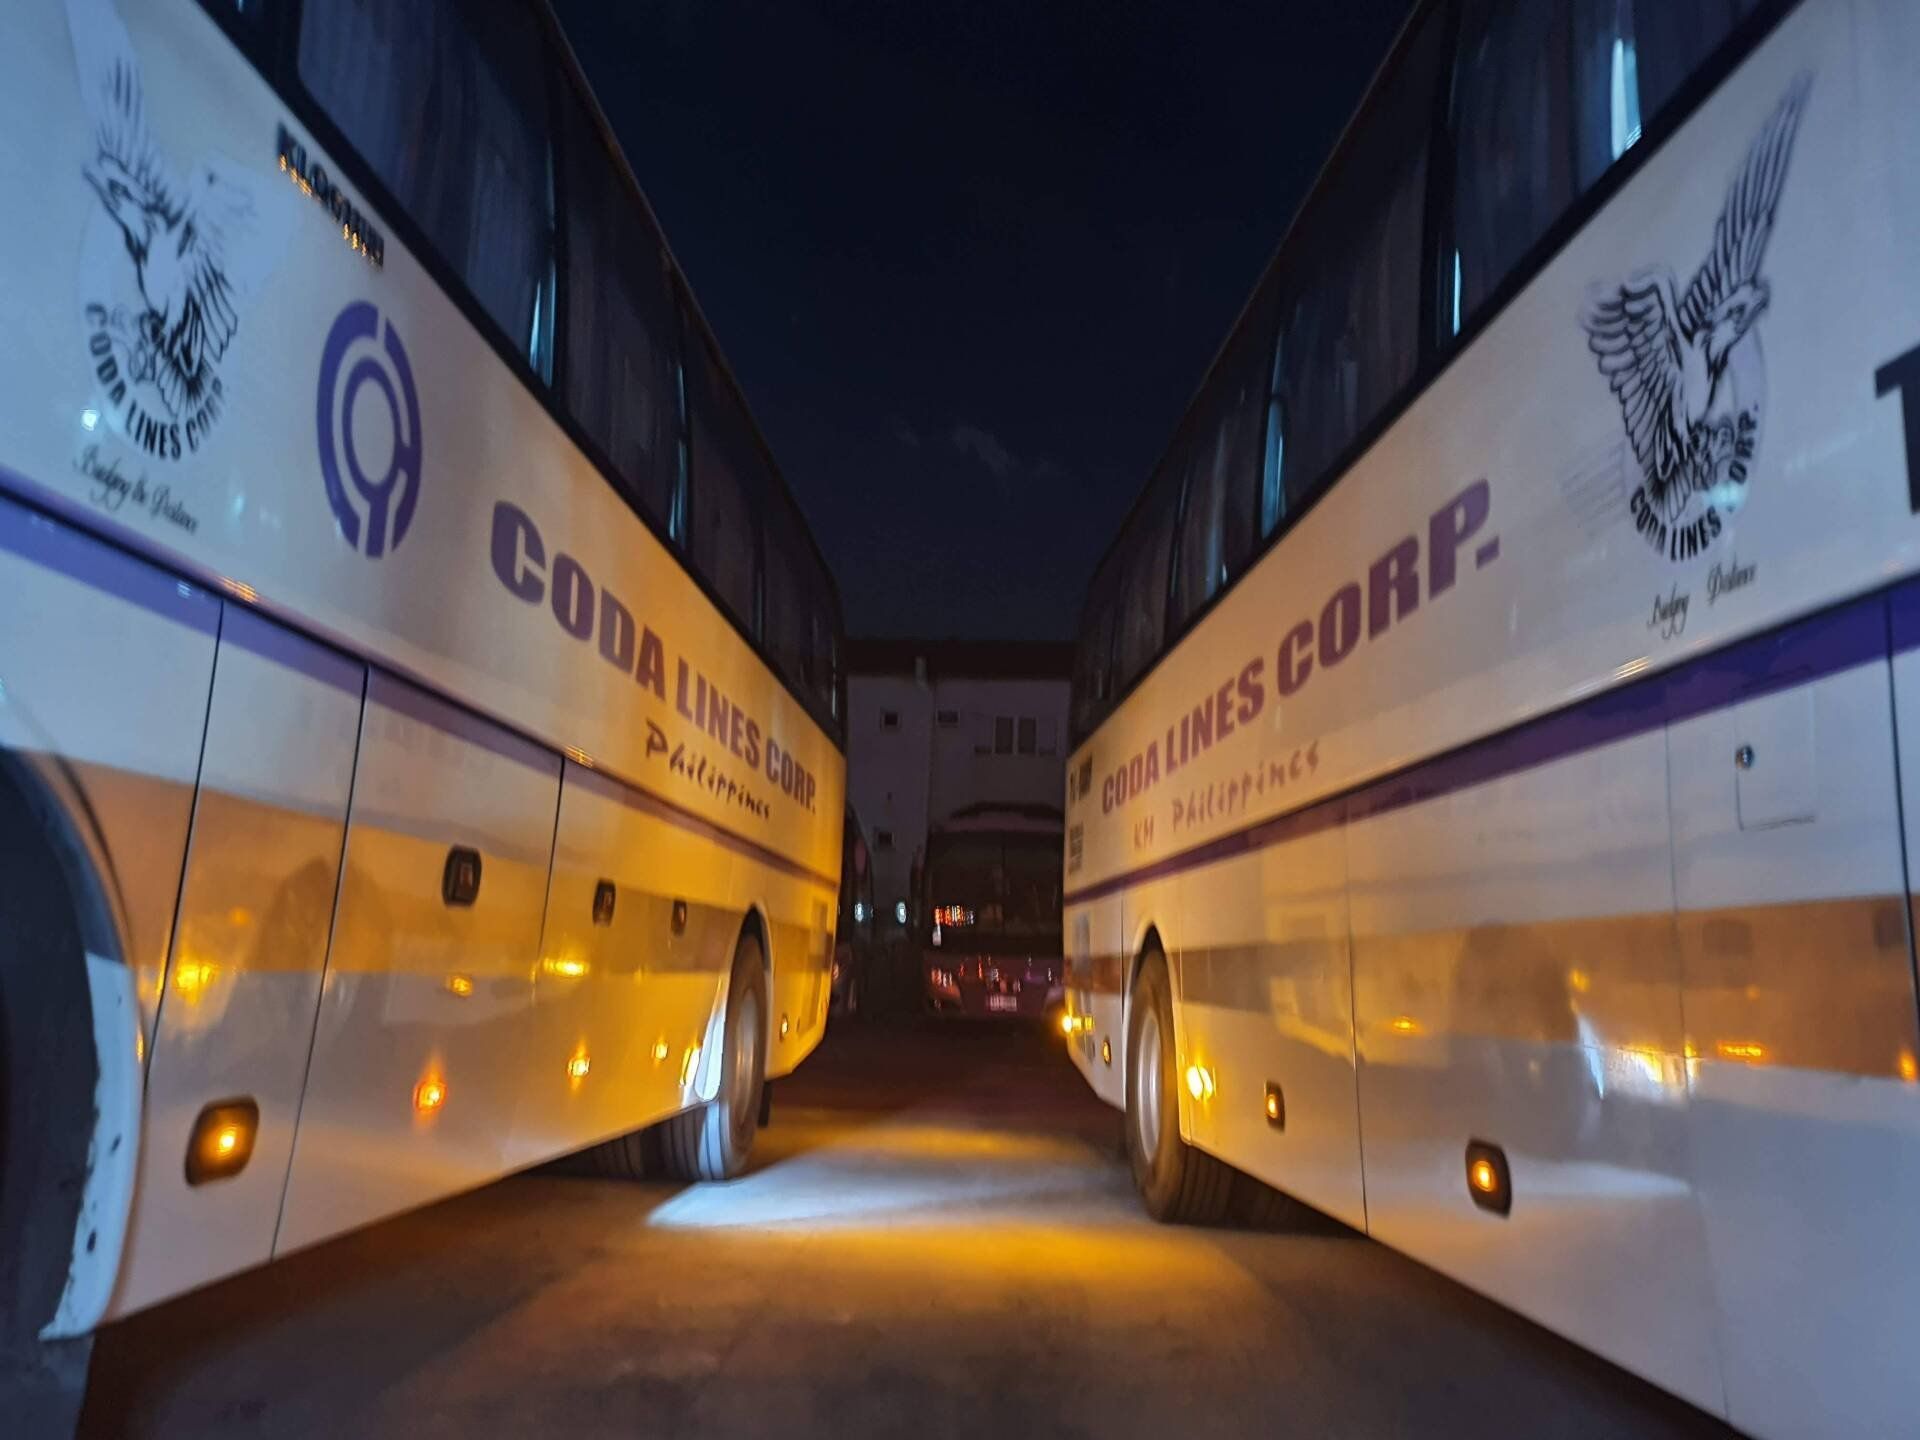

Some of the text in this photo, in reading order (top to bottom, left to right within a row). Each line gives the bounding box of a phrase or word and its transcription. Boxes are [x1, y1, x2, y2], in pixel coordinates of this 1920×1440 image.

[126, 399, 181, 460] LINES
[1670, 505, 1721, 561] LINES
[491, 500, 816, 815] CODA LINES CORP.
[1102, 740, 1160, 815] CODA
[1166, 655, 1265, 776] LINES
[1278, 478, 1500, 698] CORP.
